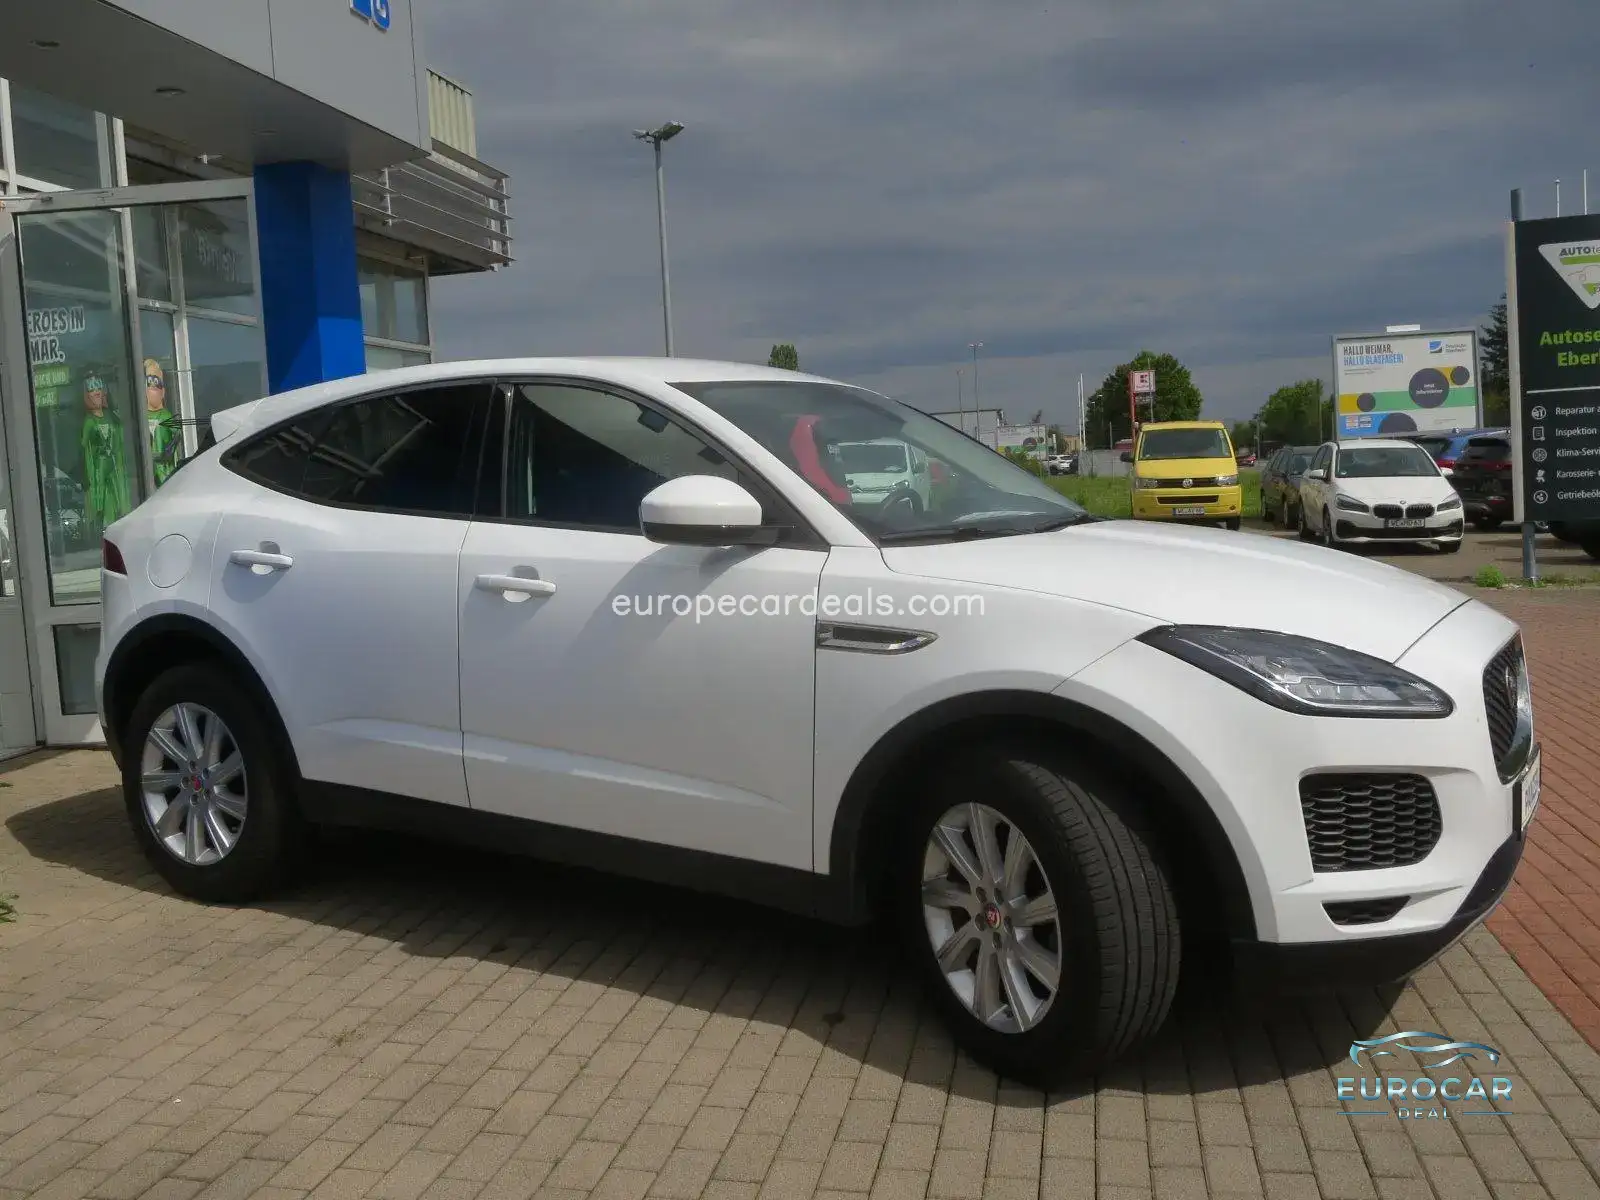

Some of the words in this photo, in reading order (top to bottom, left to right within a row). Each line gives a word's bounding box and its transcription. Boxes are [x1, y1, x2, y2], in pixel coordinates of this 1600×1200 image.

[69, 305, 86, 332] IN
[1343, 345, 1364, 356] HALLO
[1343, 355, 1364, 366] HALLO
[1557, 350, 1600, 367] Eber
[1555, 406, 1595, 417] Reparatur
[1555, 427, 1597, 438] Inspektion
